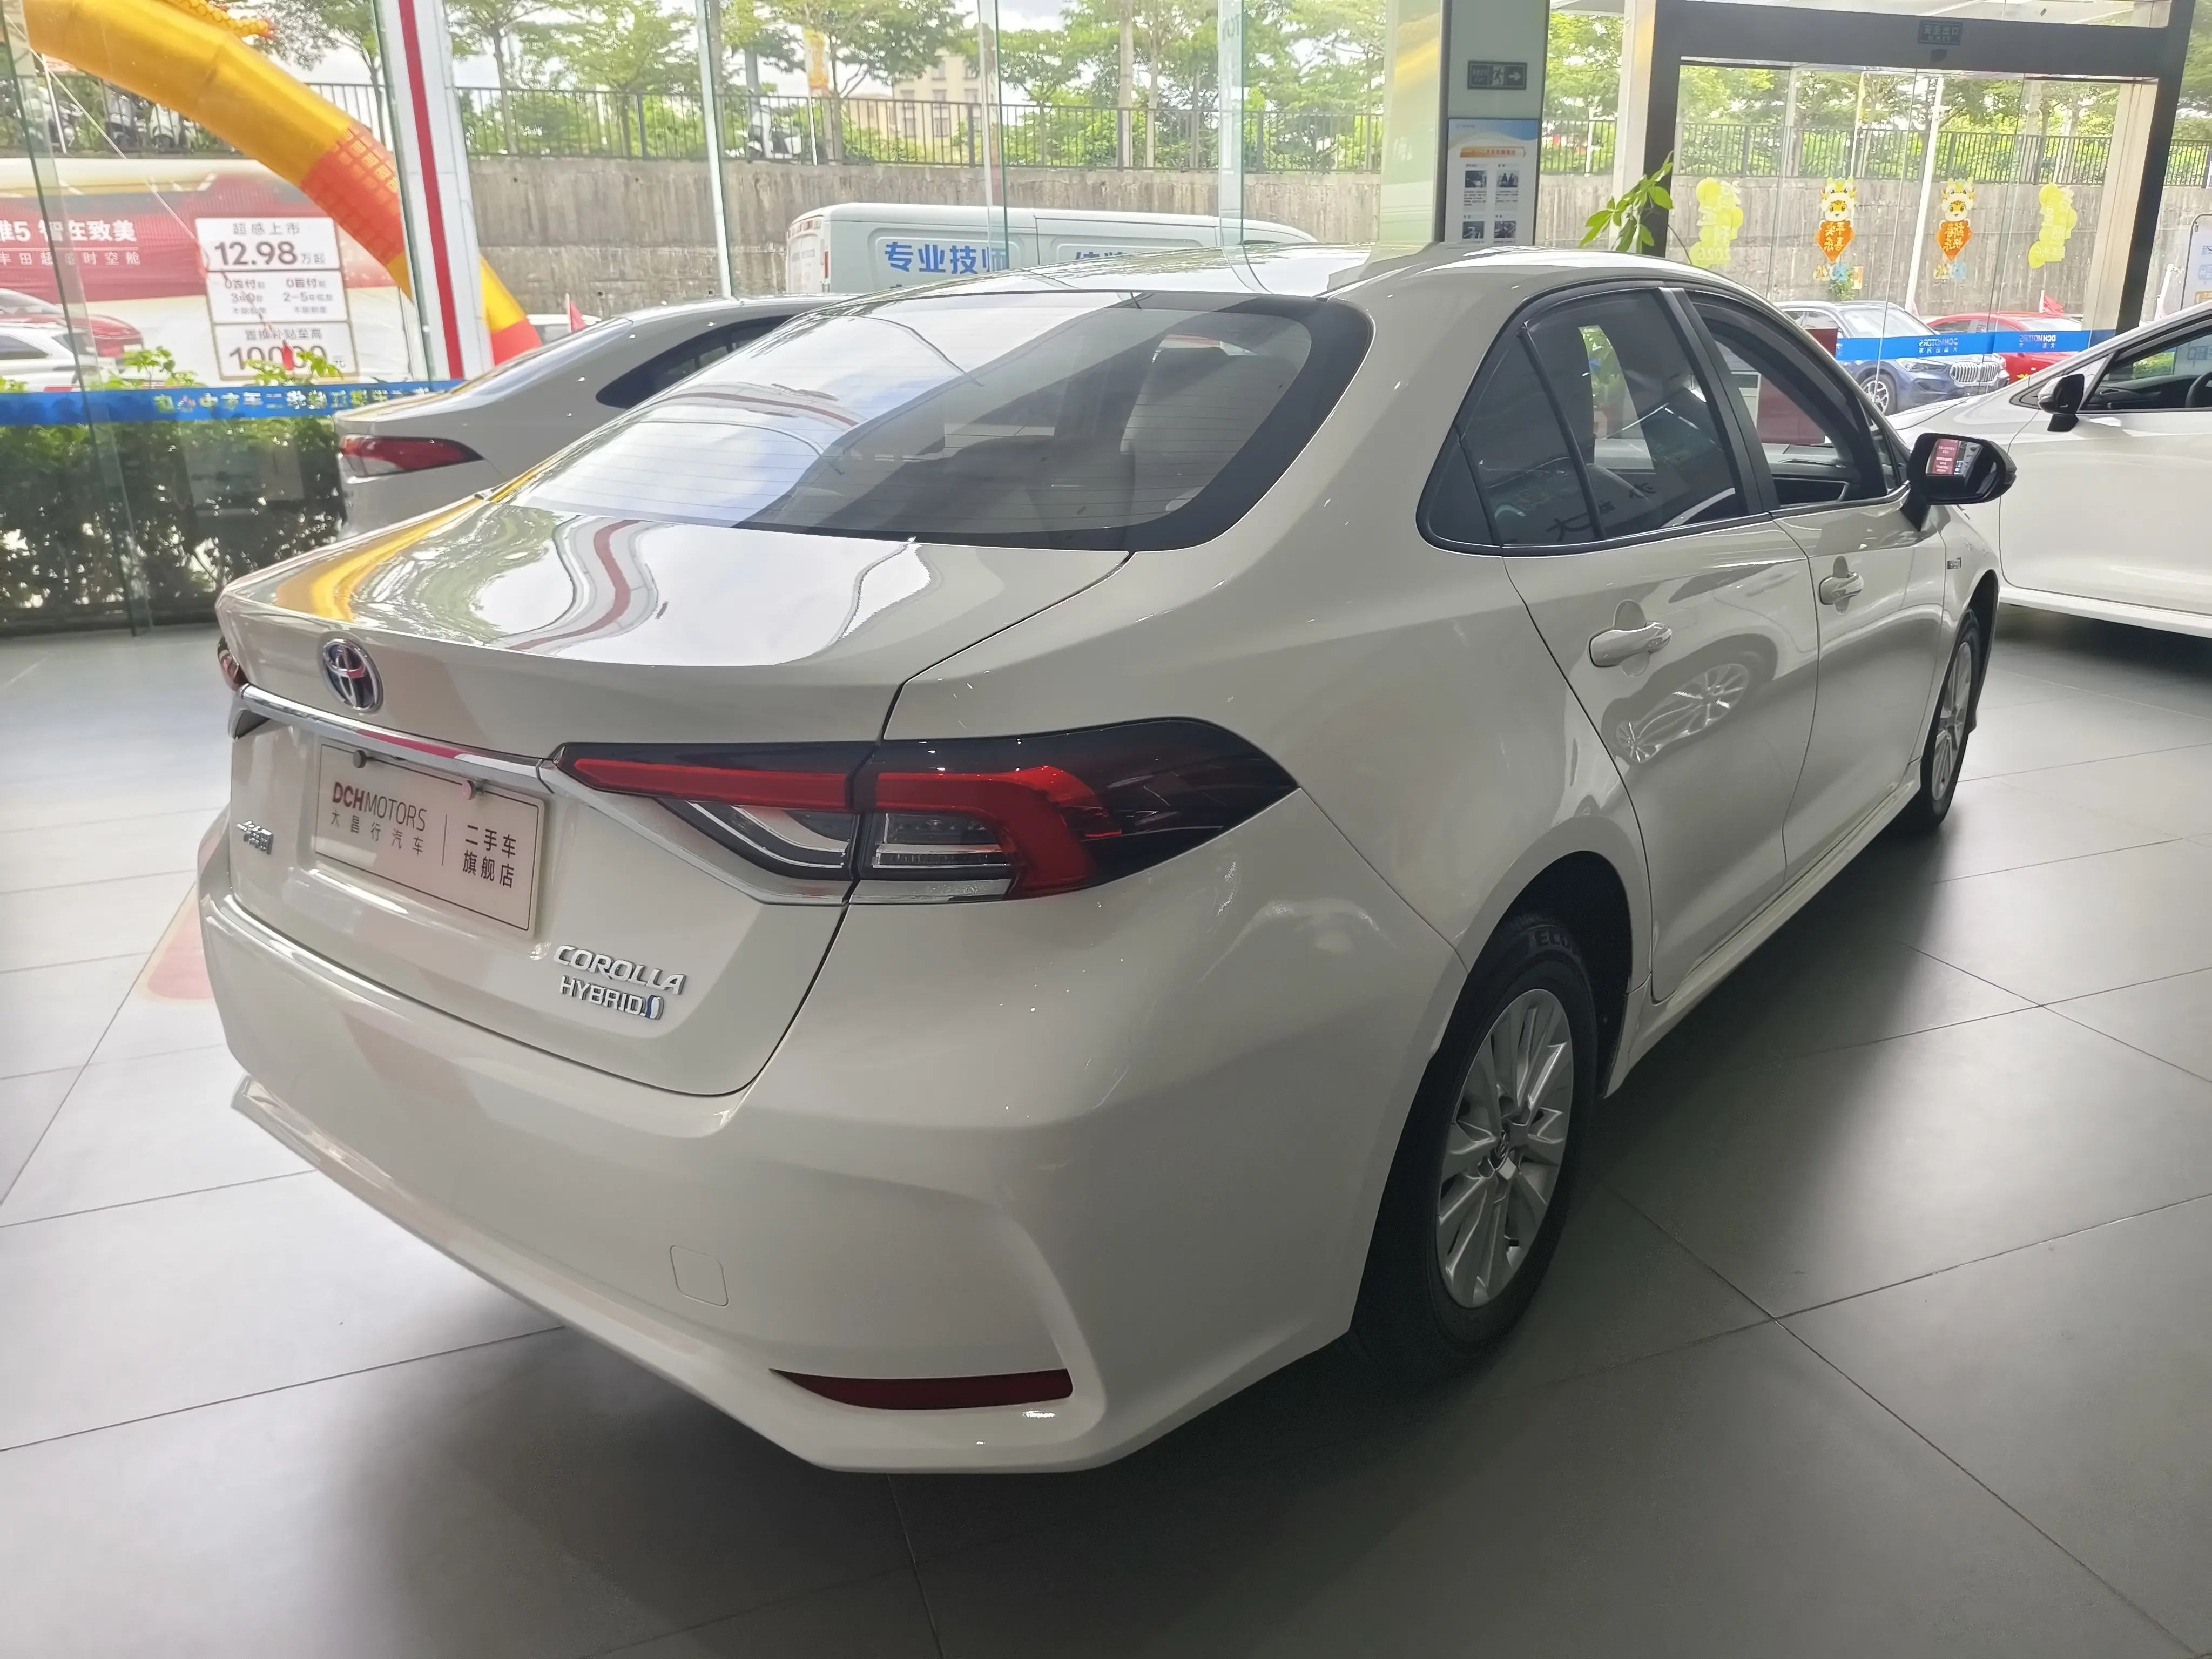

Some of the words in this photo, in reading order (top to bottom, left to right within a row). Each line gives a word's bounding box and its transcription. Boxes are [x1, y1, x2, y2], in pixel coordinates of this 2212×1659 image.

[214, 241, 298, 265] 12.98
[885, 242, 1009, 274] 专业技师
[332, 781, 427, 832] DCHMOTORS
[331, 810, 424, 856] 大昌行汽车
[465, 824, 516, 859] 二手车
[463, 849, 515, 888] 旗舰店
[553, 945, 687, 995] COROLLA
[559, 975, 646, 1016] HYBRID
